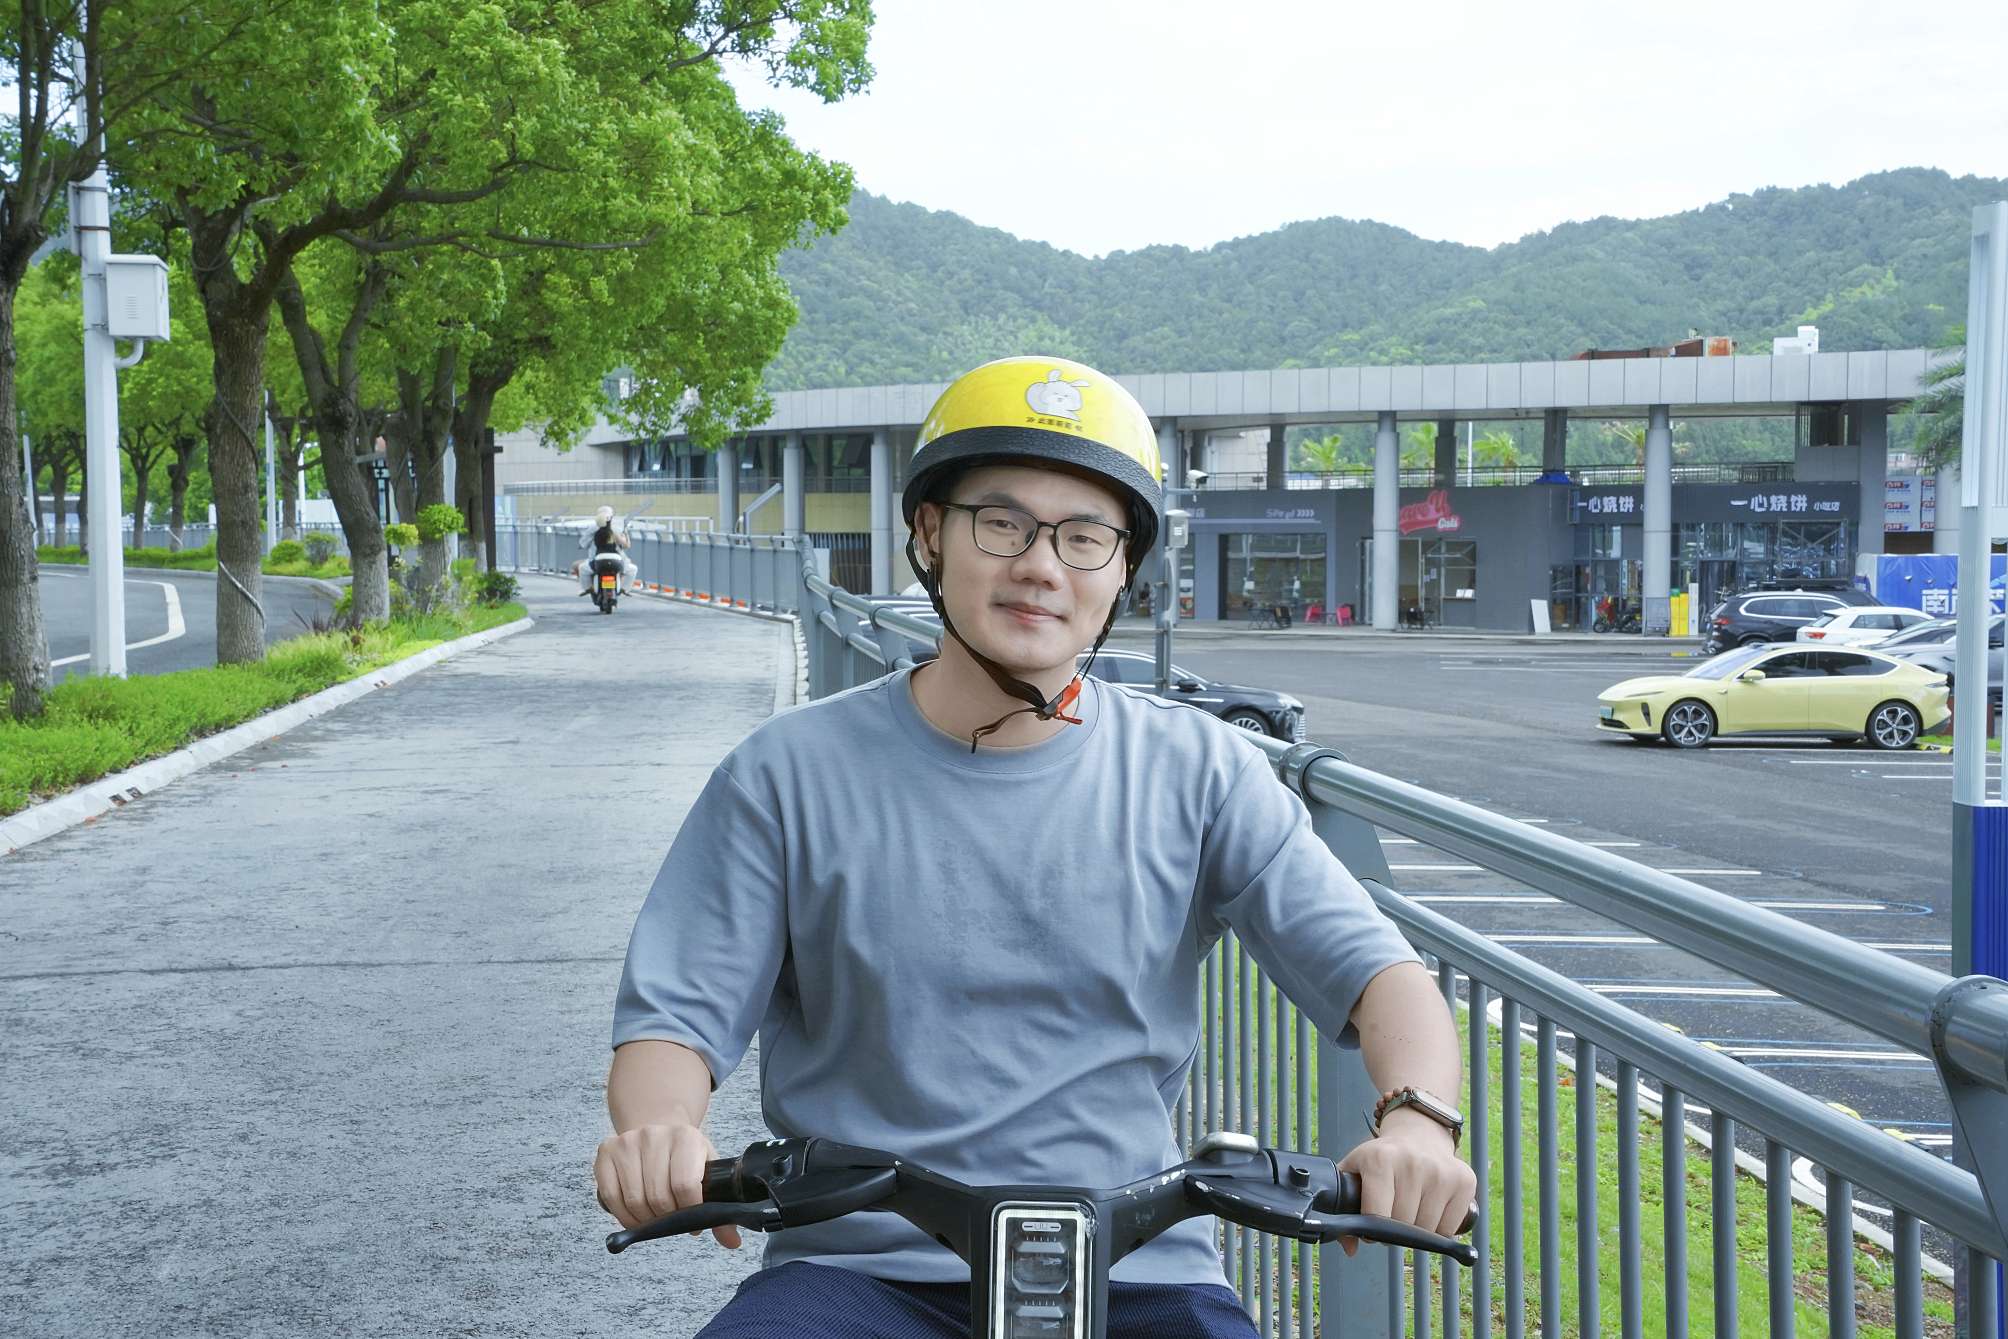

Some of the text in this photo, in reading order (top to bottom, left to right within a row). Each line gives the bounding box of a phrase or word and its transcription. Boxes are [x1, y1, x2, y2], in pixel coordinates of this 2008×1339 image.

[1577, 495, 1634, 512] 一心烧饼
[1730, 494, 1807, 512] 一心烧饼
